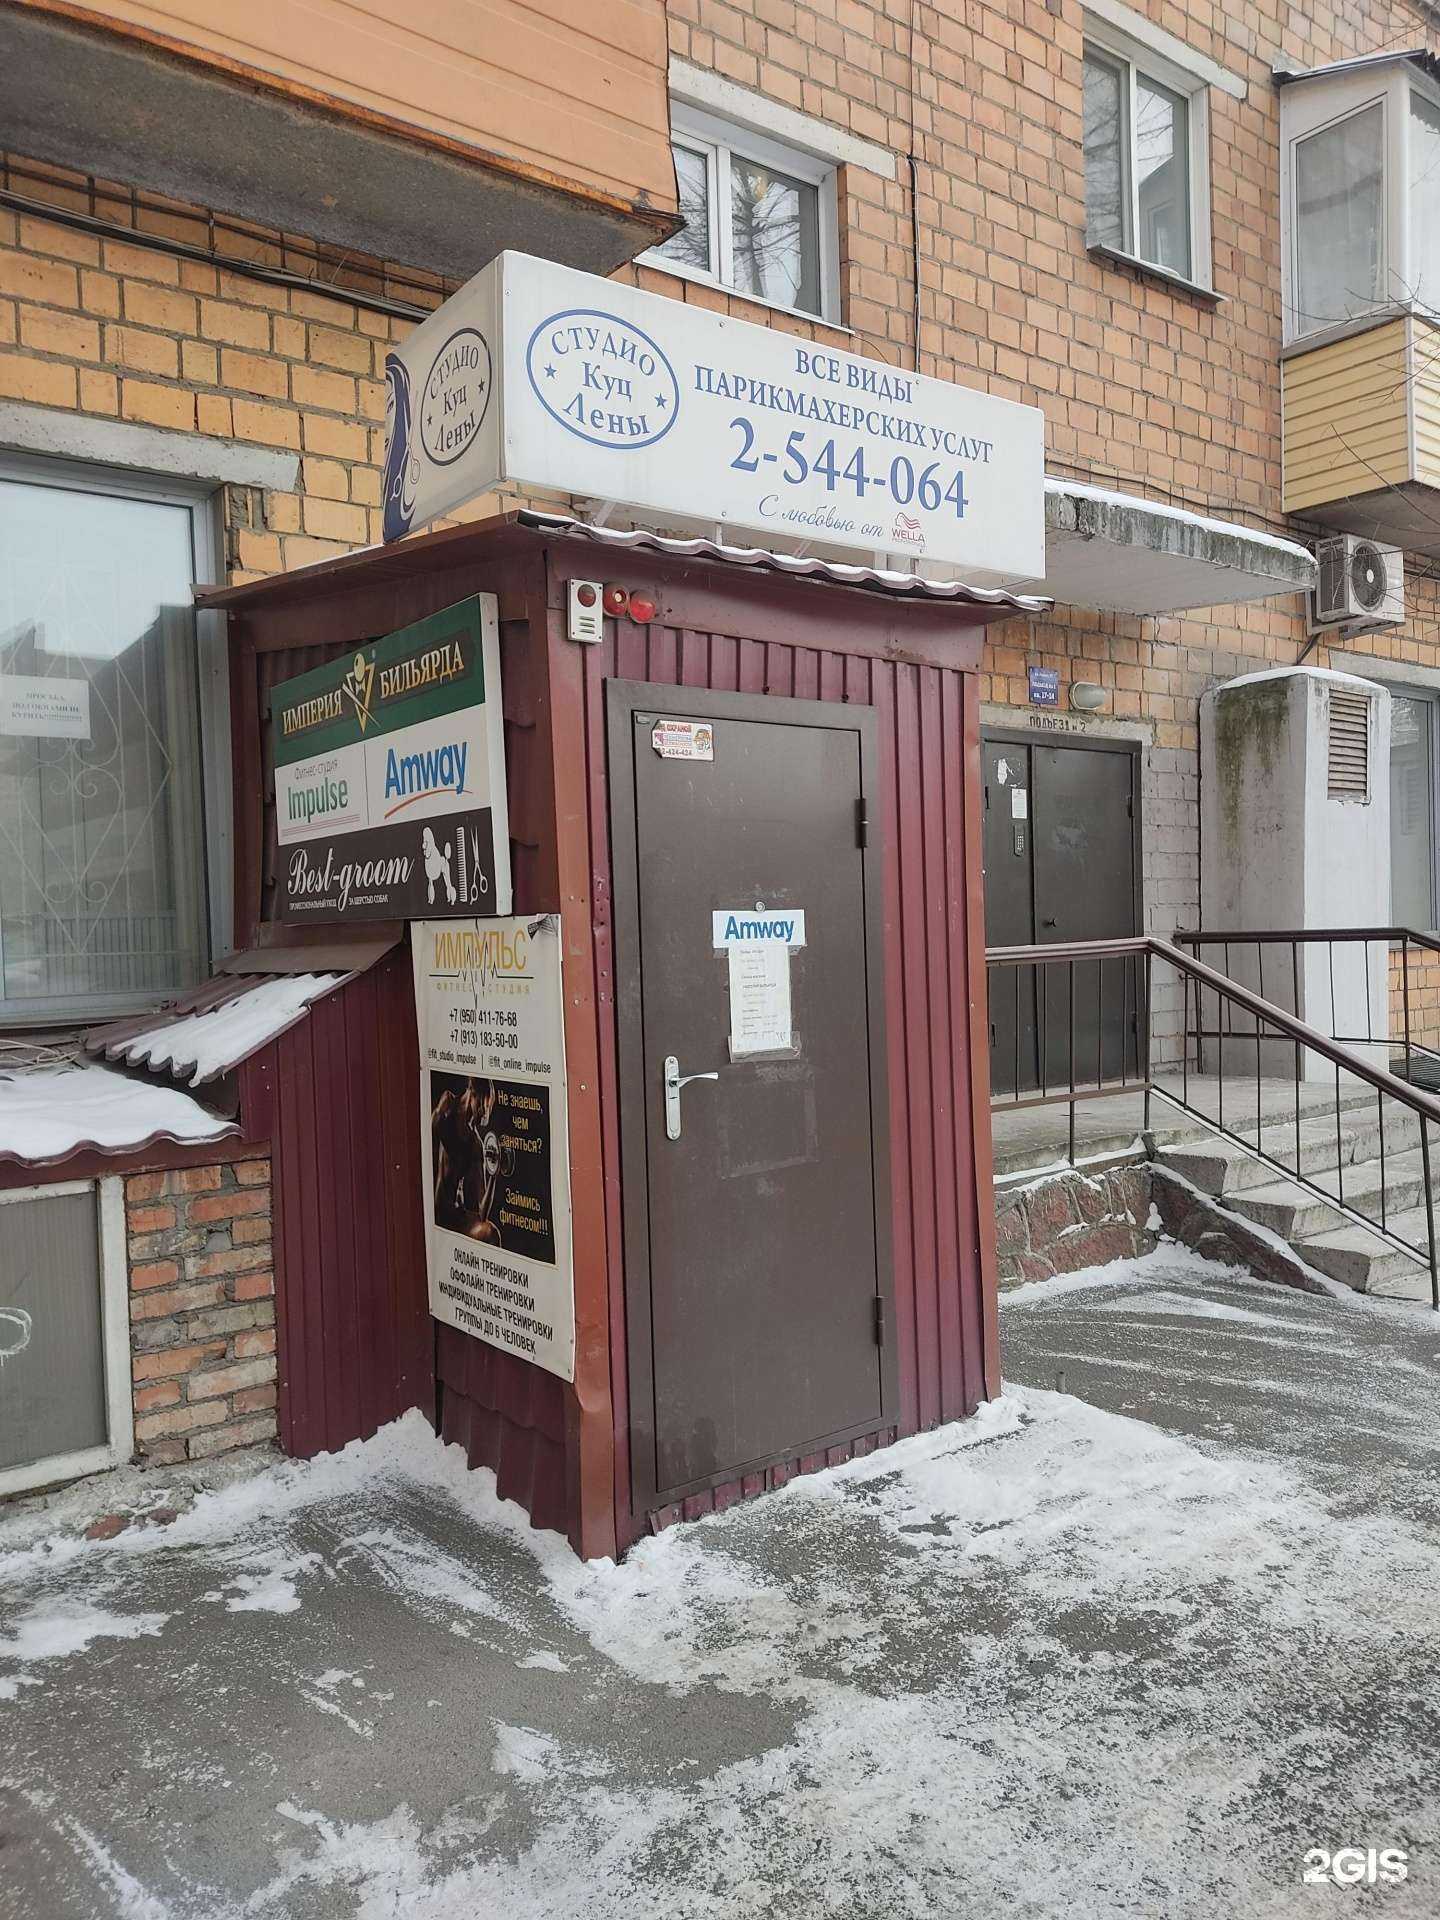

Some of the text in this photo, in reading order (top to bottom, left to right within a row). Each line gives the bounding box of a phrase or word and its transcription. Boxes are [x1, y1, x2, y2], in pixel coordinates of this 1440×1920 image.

[430, 345, 479, 399] СТУДИО
[551, 327, 655, 376] СТУДИО
[581, 361, 632, 402] Куц
[795, 348, 912, 404] ВСЕ ВИДЫ
[443, 385, 467, 416] Куц
[562, 392, 651, 436] Лены
[694, 364, 993, 463] ПАРИКМАХЕРСКИХ УСЛУГ
[434, 409, 476, 452] Лены
[729, 417, 969, 518] 2-544-064
[758, 494, 884, 537] С любовью от
[891, 528, 926, 544] WELLA
[282, 640, 465, 735] ИМПЕРИЯ БИЛЬЯРДА
[384, 740, 468, 799] Amway
[287, 776, 349, 823] Impulse
[287, 848, 415, 912] Best-groom
[435, 928, 527, 971] ИМПУЛЬС
[724, 915, 795, 942] Amway
[449, 1008, 518, 1027] +7 (950) 411-76-68
[450, 1029, 518, 1049] +7 (913) 183-50-00
[498, 1090, 544, 1114] Не знаешь,
[512, 1116, 528, 1131] чем
[505, 1187, 541, 1212] Займись
[499, 1208, 549, 1236] фитнесом!!!
[450, 1266, 535, 1312] ОФФЛАЙН ТРЕНИРОВКИ
[453, 1247, 529, 1288] ОНЛАЙН ТРЕНИРОВКИ
[438, 1280, 553, 1341] ИНДИВИДУАЛЬНЫЕ ТРЕНИРОВКИ
[455, 1307, 536, 1354] ГРУППЫ ДО 6 ЧЕЛОВЕК
